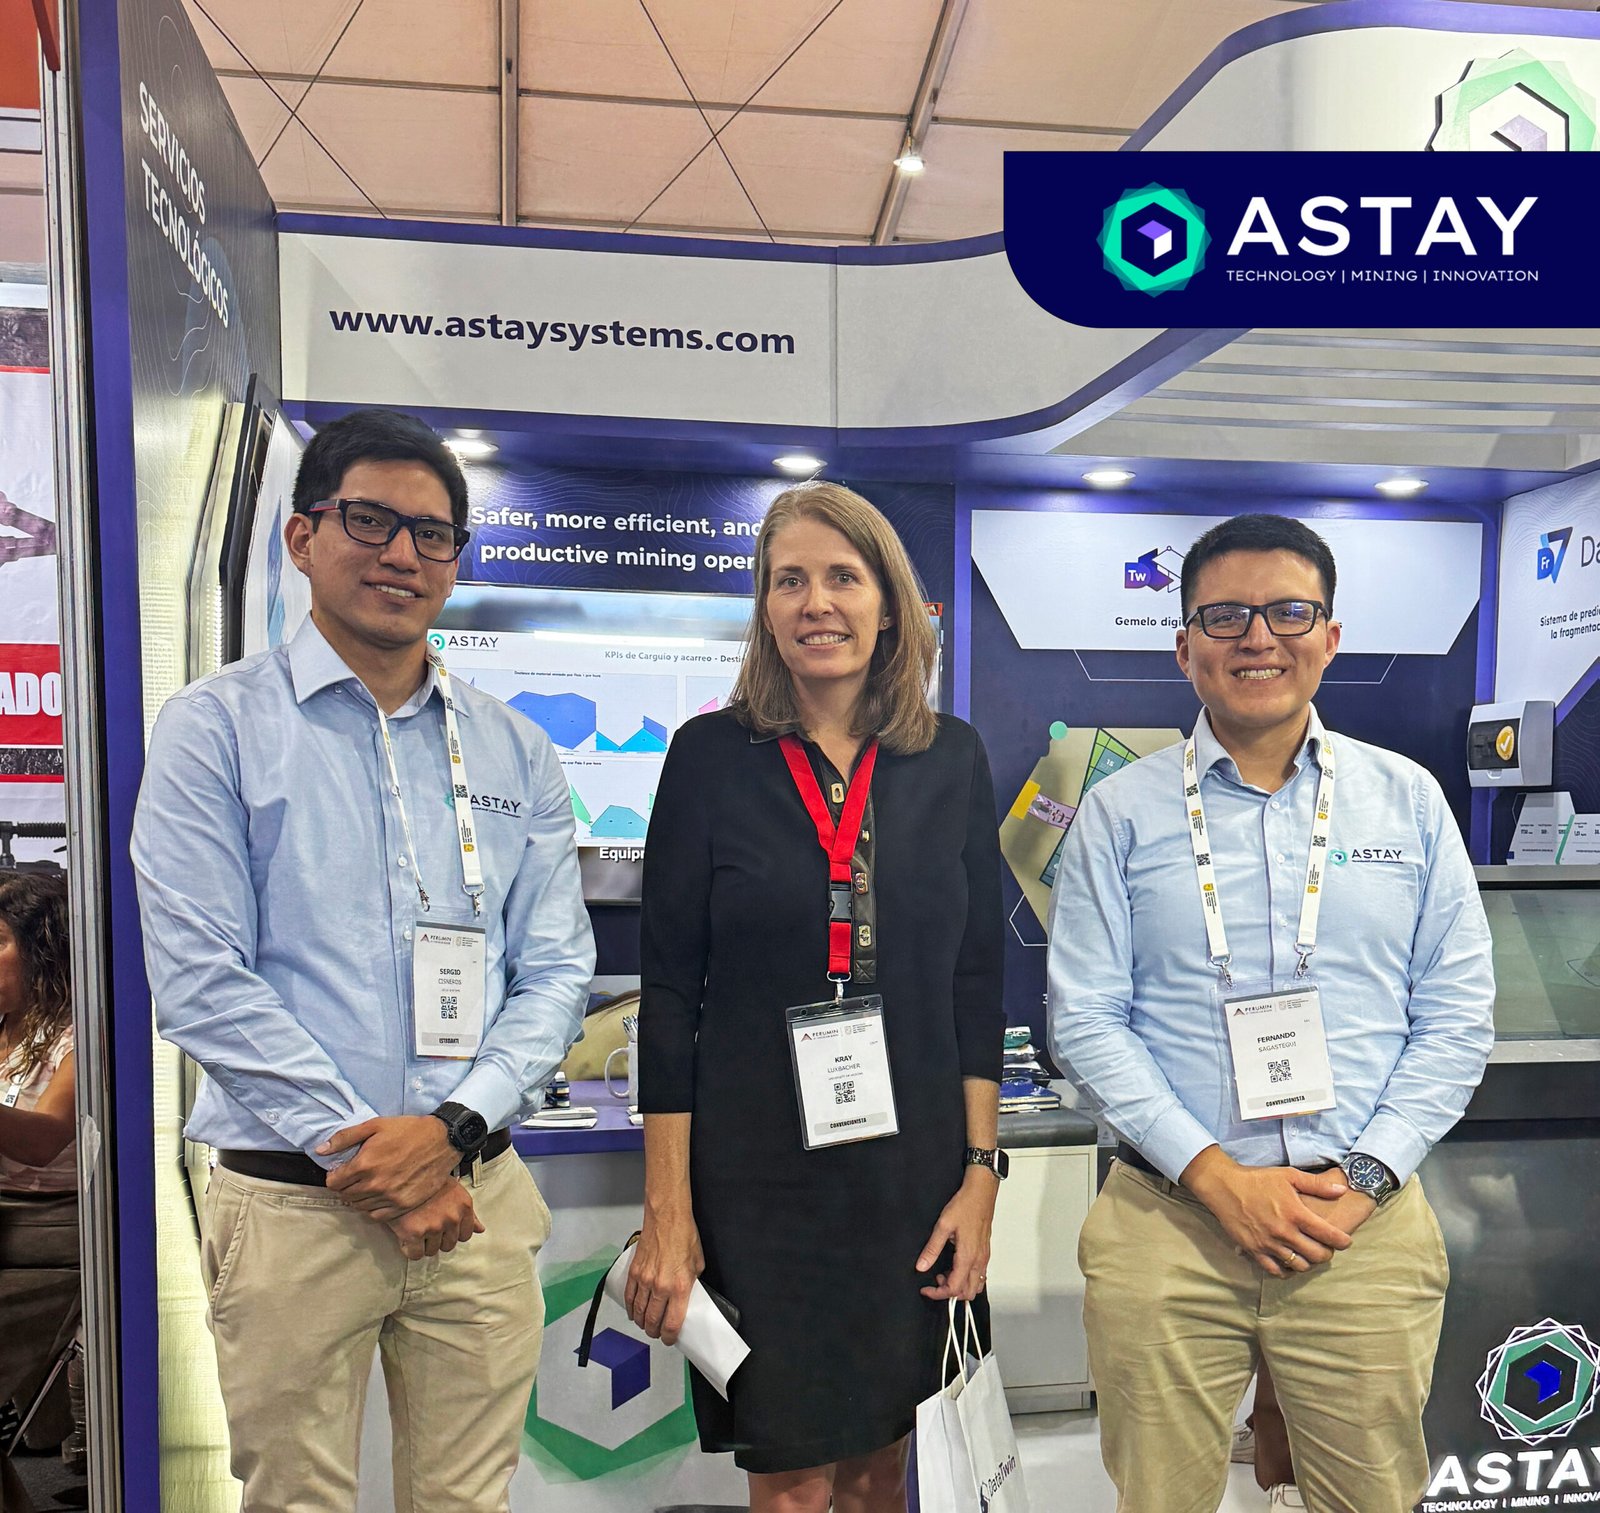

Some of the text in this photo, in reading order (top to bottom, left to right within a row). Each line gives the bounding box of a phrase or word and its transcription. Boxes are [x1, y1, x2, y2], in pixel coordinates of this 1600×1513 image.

[139, 81, 206, 225] SERVICIOS
[141, 158, 229, 329] TECNOLÓGICOS
[329, 309, 796, 355] www.astaysystems.com
[471, 507, 539, 530] Safer,
[545, 513, 607, 530] more
[613, 513, 717, 538] efficient,
[480, 543, 609, 564] productive
[616, 547, 697, 571] mining
[1541, 556, 1551, 570] Fr
[1128, 569, 1147, 581] Tw
[1115, 616, 1157, 626] Gemelo
[1540, 612, 1567, 627] Sistema
[1569, 611, 1579, 622] de
[448, 635, 499, 648] ASTAY
[1550, 629, 1558, 640] la
[625, 651, 637, 660] de
[680, 654, 713, 663] acarreo
[470, 794, 521, 813] ASTAY
[1351, 848, 1402, 860] ASTAY
[440, 968, 461, 976] SERGIO
[1257, 1031, 1296, 1043] FERNANDO
[1258, 1041, 1297, 1052] SAGASTEGUI
[834, 1055, 853, 1063] KRAY
[987, 1454, 1017, 1498] DataTwin
[1425, 1446, 1600, 1497] ASTA
[1422, 1498, 1498, 1513] TECHNOLOGY
[1511, 1494, 1550, 1508] MINING
